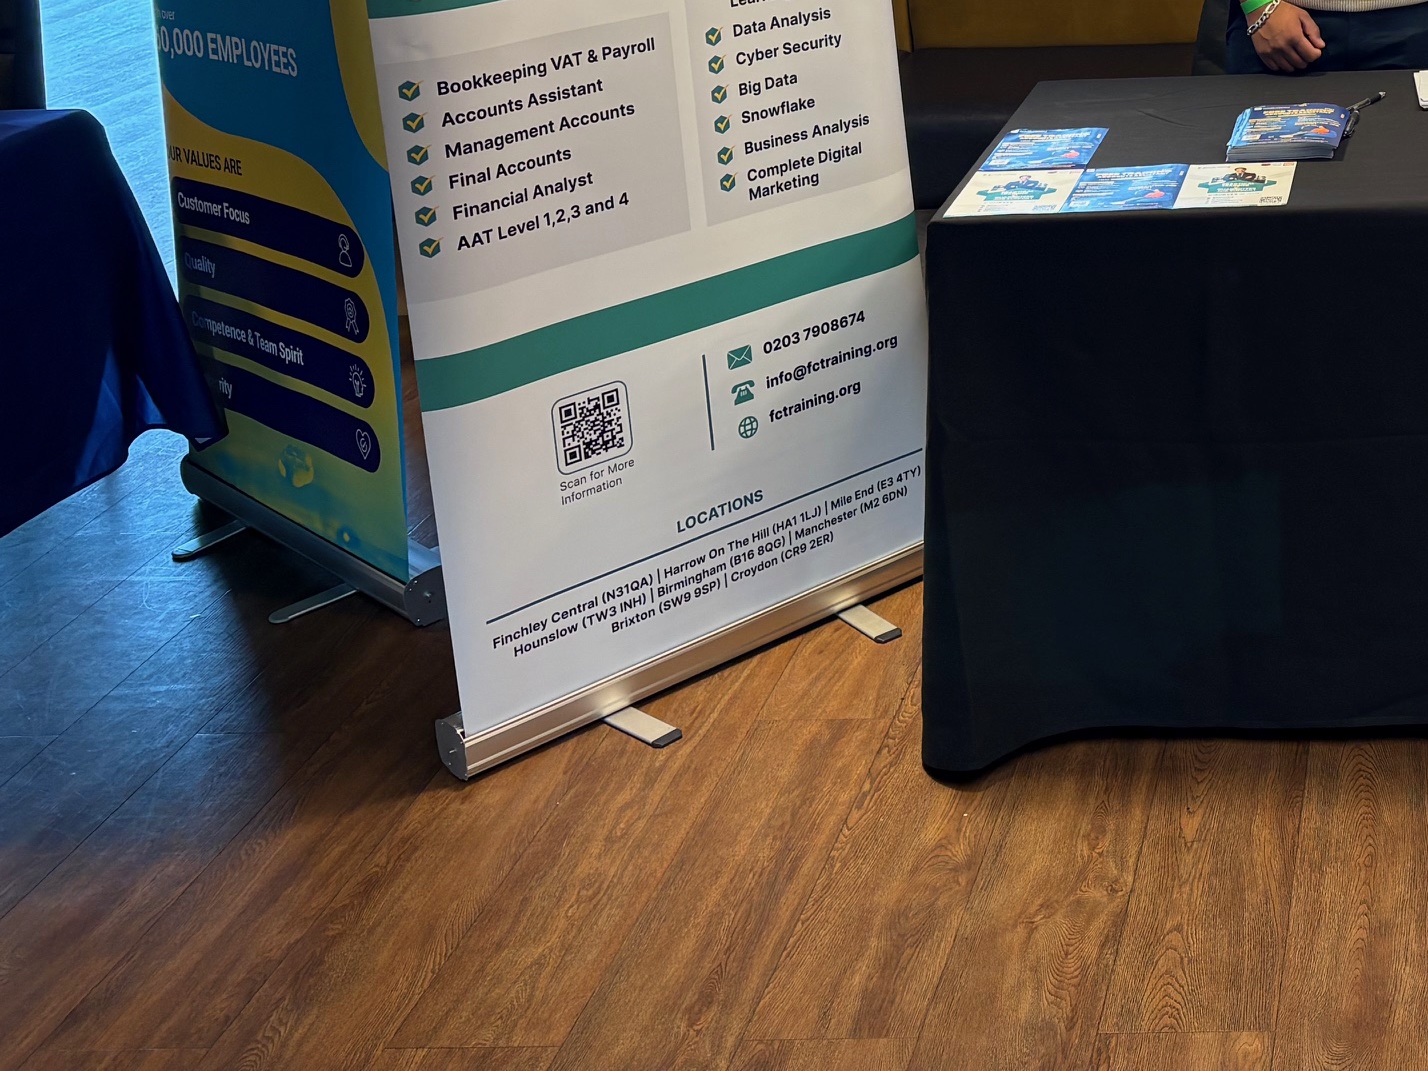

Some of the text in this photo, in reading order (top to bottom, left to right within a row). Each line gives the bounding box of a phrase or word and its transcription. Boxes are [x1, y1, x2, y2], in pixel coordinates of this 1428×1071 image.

[733, 8, 830, 37] Data Analysis
[207, 33, 297, 77] EMPLOYEES
[437, 37, 654, 95] Bookkeeping VAT & Payroll
[736, 35, 841, 66] Cyber Security
[442, 79, 603, 127] Accounts Assistant
[739, 74, 797, 96] Big Data
[742, 99, 814, 123] Snowflake
[445, 105, 634, 158] Management Accounts
[745, 114, 869, 154] Business Analysis
[183, 148, 221, 170] VALUES
[224, 158, 242, 175] ARE
[449, 150, 571, 189] Final Accounts
[748, 142, 861, 181] Complete Digital
[453, 173, 593, 220] Financial Analyst
[749, 173, 818, 200] Marketing
[178, 192, 250, 224] Customer Focus
[458, 193, 629, 250] AAT Level 1,2,3 and 4
[185, 252, 216, 279] Quality
[248, 329, 255, 347] &
[254, 332, 277, 355] Team
[279, 342, 304, 365] Spirit
[764, 311, 865, 353] 0203 7908674
[766, 336, 897, 388] info@fctraining.org
[770, 382, 860, 422] fctraining.org
[560, 460, 634, 491] Scan for More
[562, 478, 622, 505] Information
[677, 490, 763, 533] LOCATIONS
[612, 531, 833, 633] Brixton (SW9 9SP) Croydon (CR9 2ER)
